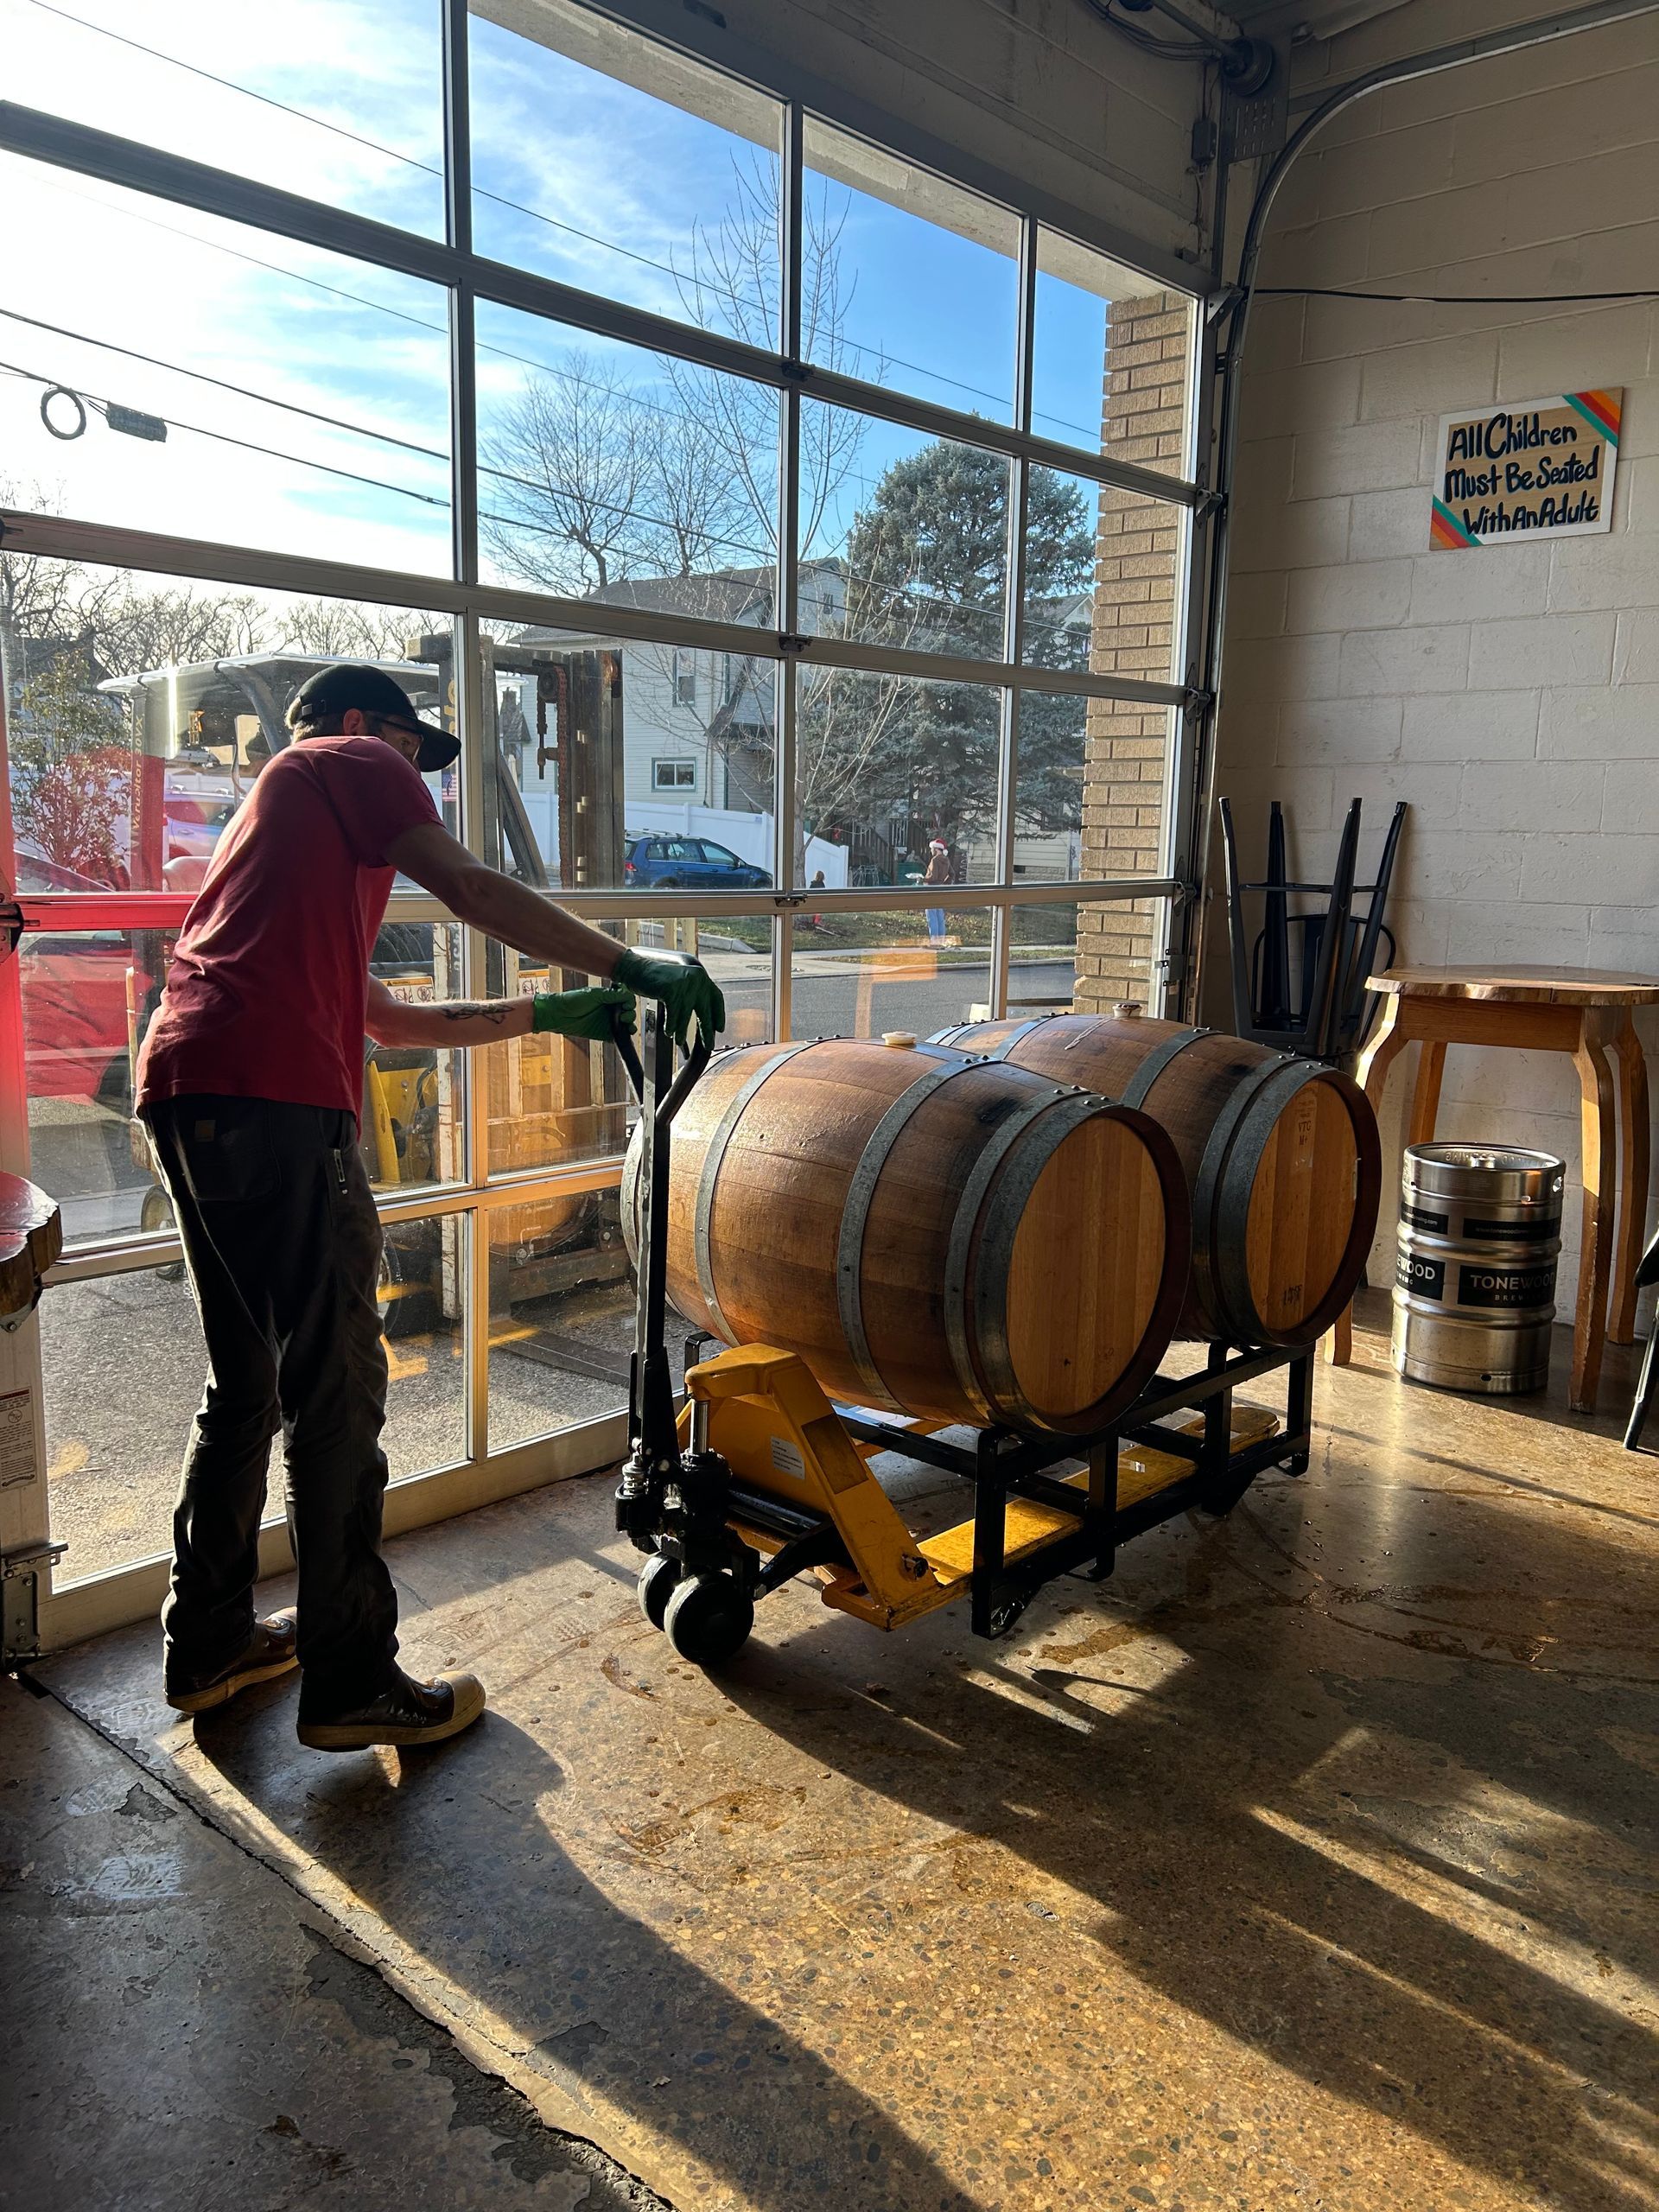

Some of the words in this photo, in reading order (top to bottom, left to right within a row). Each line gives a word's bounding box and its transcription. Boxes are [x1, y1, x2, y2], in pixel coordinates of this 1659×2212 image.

[1449, 423, 1482, 461] All
[1484, 413, 1577, 459] Children
[1445, 464, 1502, 503] Must
[1505, 462, 1535, 493] Be
[1537, 445, 1599, 489] Seated
[1463, 502, 1510, 535] With
[1511, 505, 1538, 531] An
[1538, 490, 1599, 527] Adult
[1397, 1254, 1435, 1280] EWOOD
[1469, 1272, 1554, 1290] TONEWOOD
